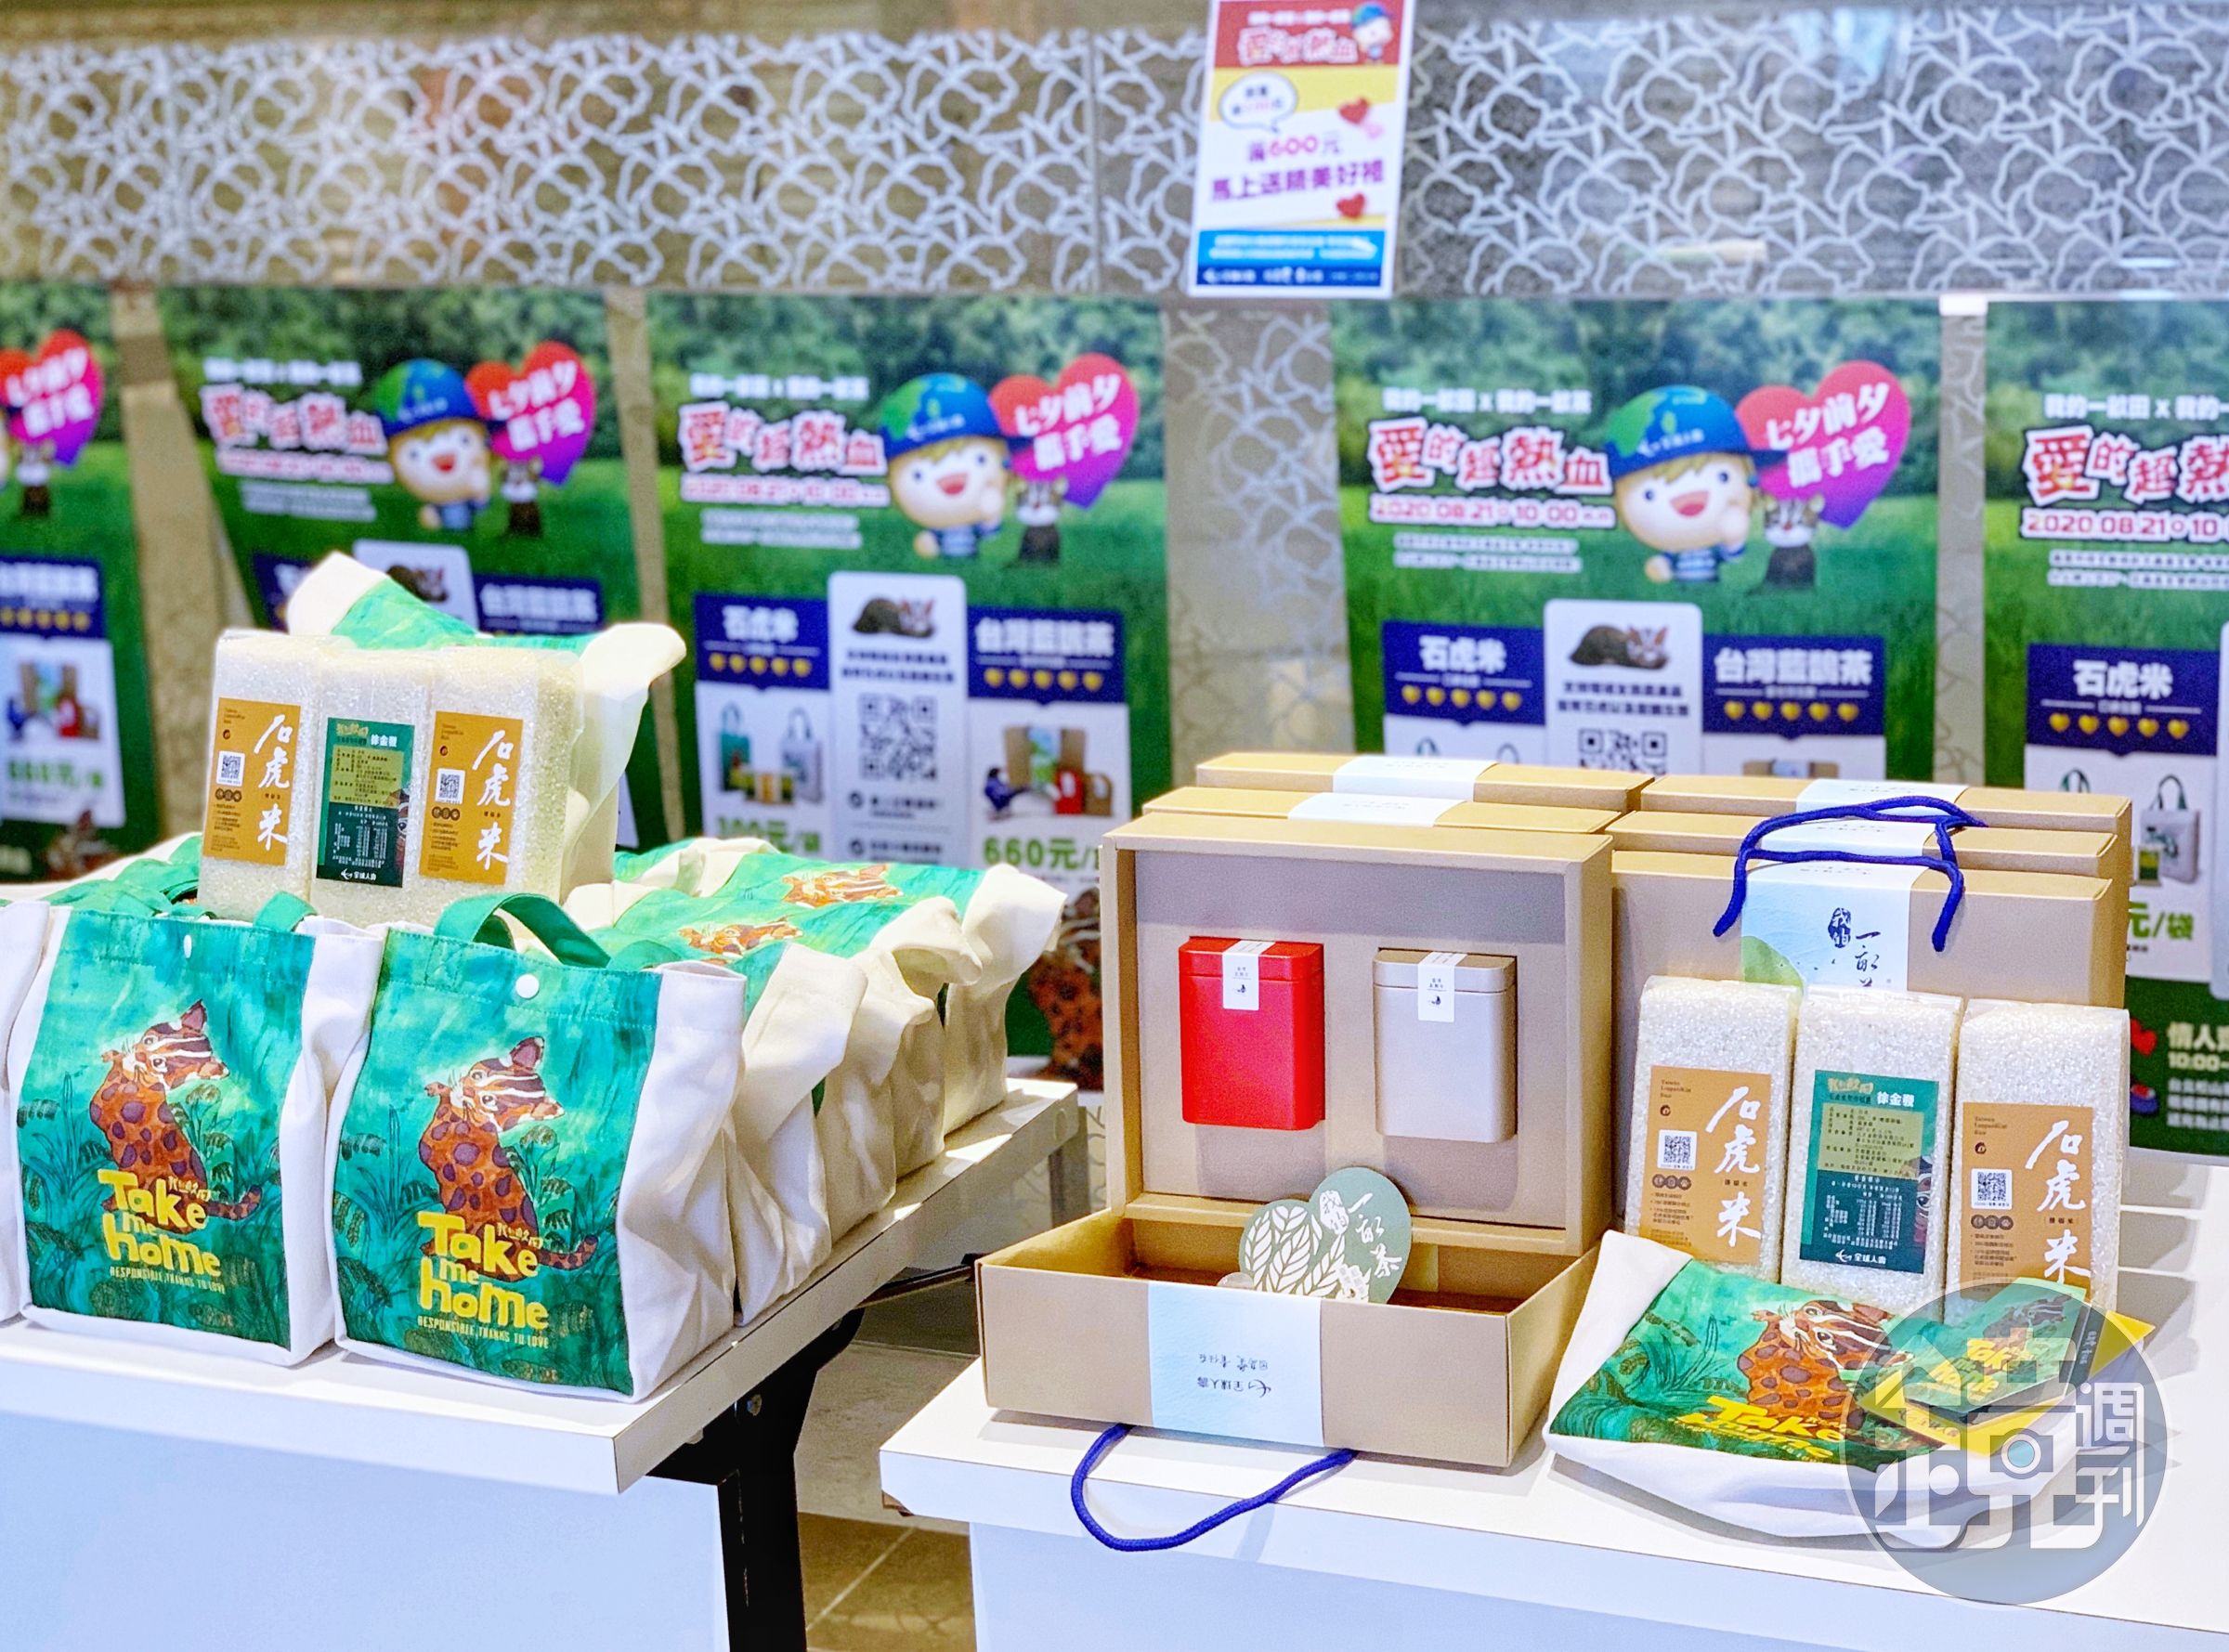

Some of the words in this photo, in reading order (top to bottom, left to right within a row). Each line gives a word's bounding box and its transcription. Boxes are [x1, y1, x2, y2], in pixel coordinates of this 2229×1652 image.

[1766, 383, 1889, 450] 七夕前夕
[1419, 634, 1506, 674] 石虎米
[2073, 659, 2173, 699] 石虎米
[254, 713, 293, 851] 石虎米
[472, 730, 514, 870] 石虎米
[984, 837, 1100, 870] 660元/
[98, 1168, 207, 1229] Take
[1705, 1086, 1762, 1247] 石虎米
[122, 1212, 157, 1236] me
[2025, 1119, 2092, 1285] 石虎米
[102, 1213, 222, 1277] home
[417, 1210, 539, 1278] Take
[439, 1257, 479, 1285] me
[420, 1256, 549, 1330] home
[1707, 1395, 1844, 1443] Take
